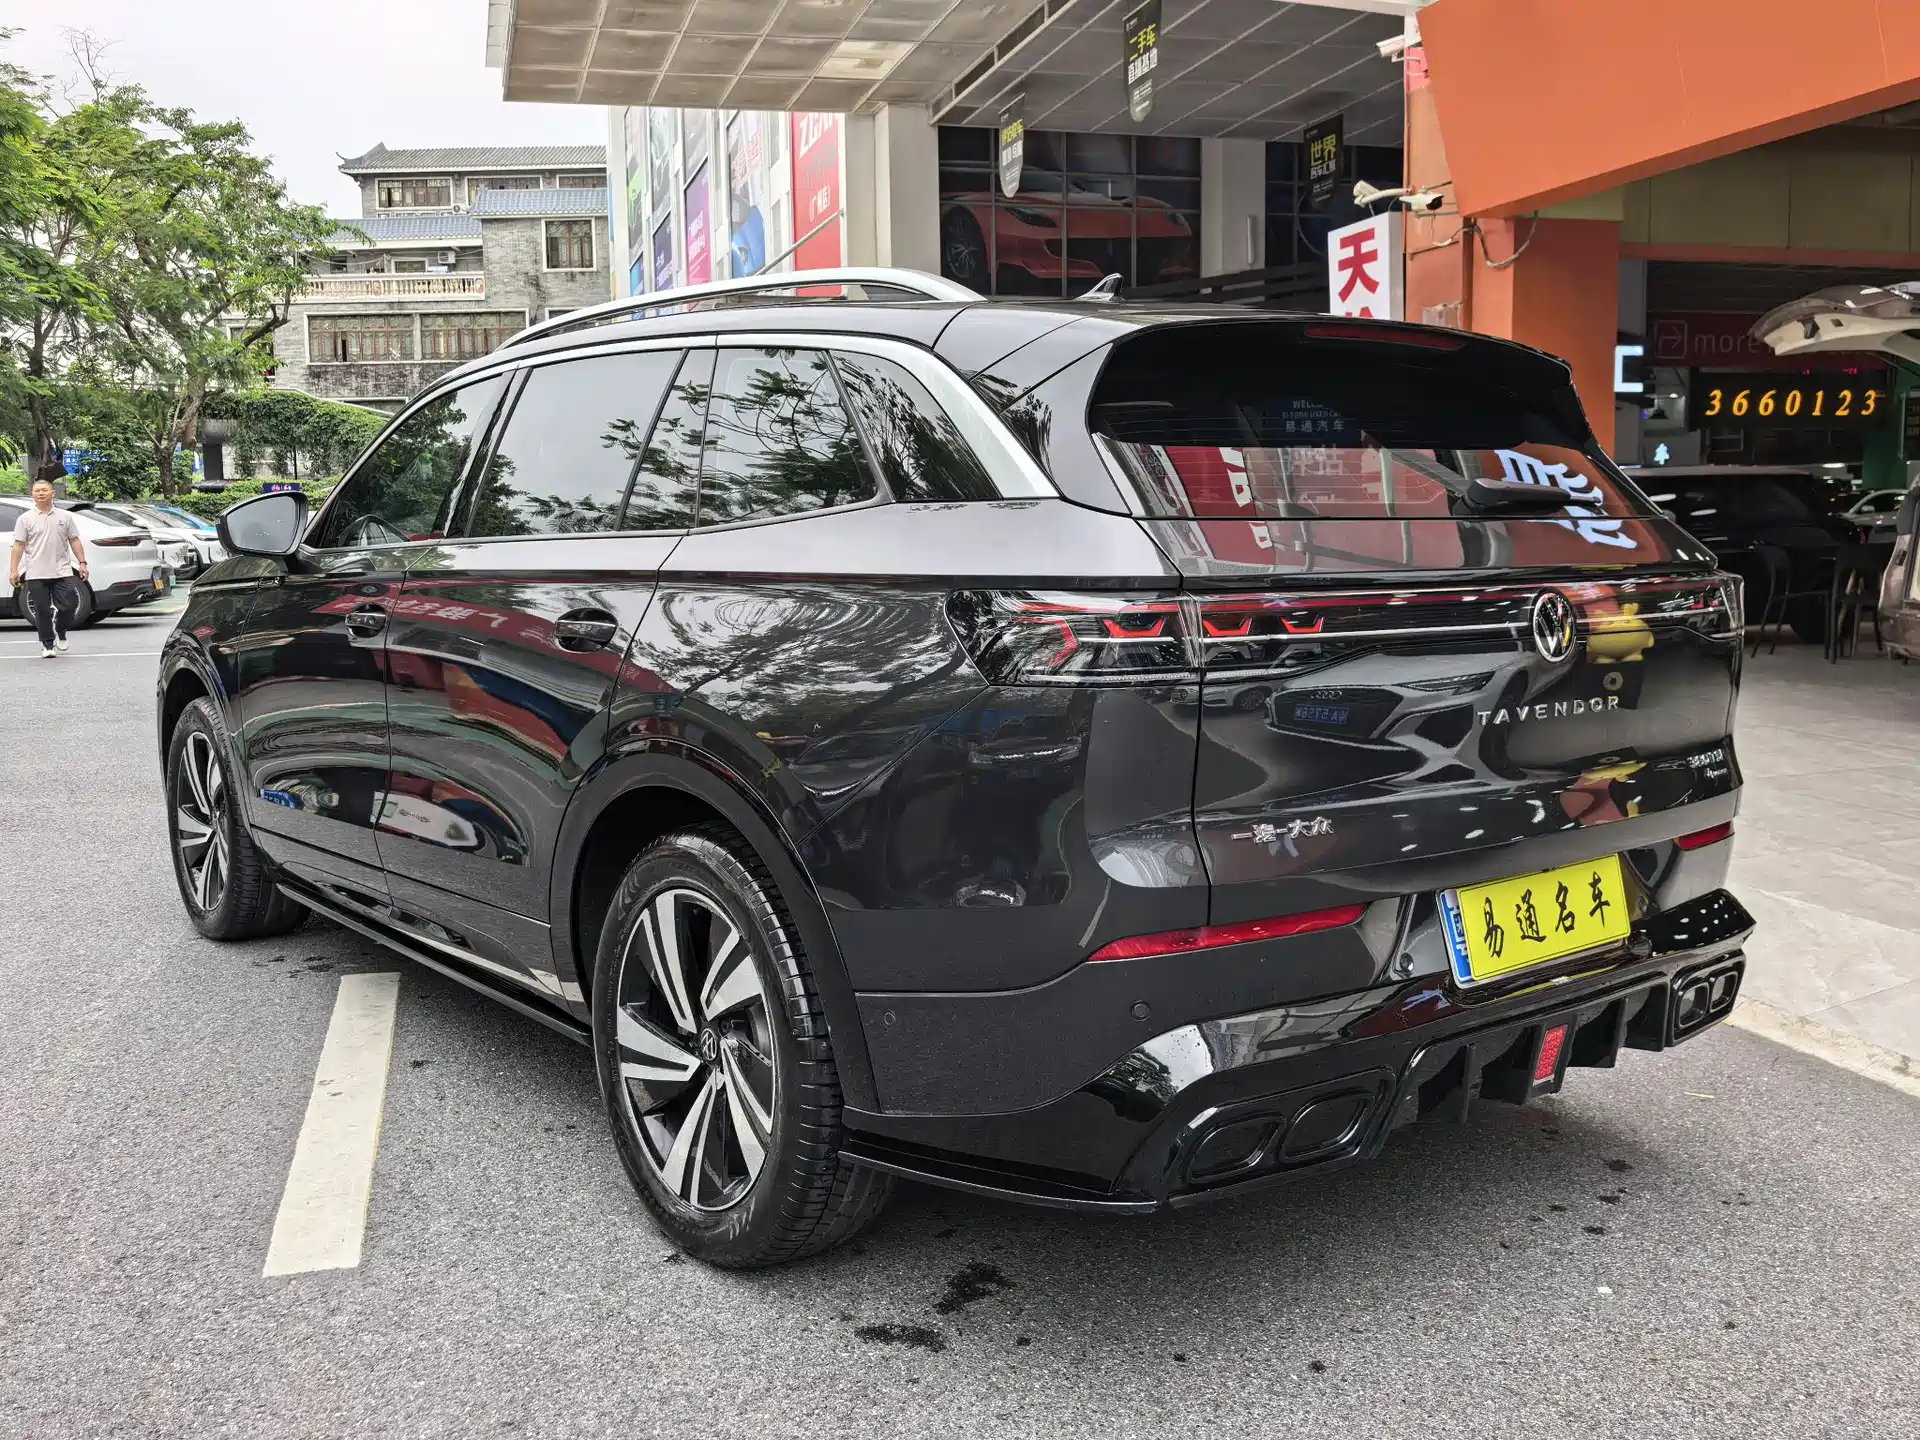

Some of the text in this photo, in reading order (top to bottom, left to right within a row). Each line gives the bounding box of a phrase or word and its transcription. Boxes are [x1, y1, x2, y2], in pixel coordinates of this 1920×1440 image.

[1129, 24, 1156, 61] 二手车
[1310, 133, 1336, 166] 世界
[1338, 227, 1380, 318] 天
[1476, 695, 1620, 726] TAVENDOR
[1484, 871, 1611, 959] 易通名车
